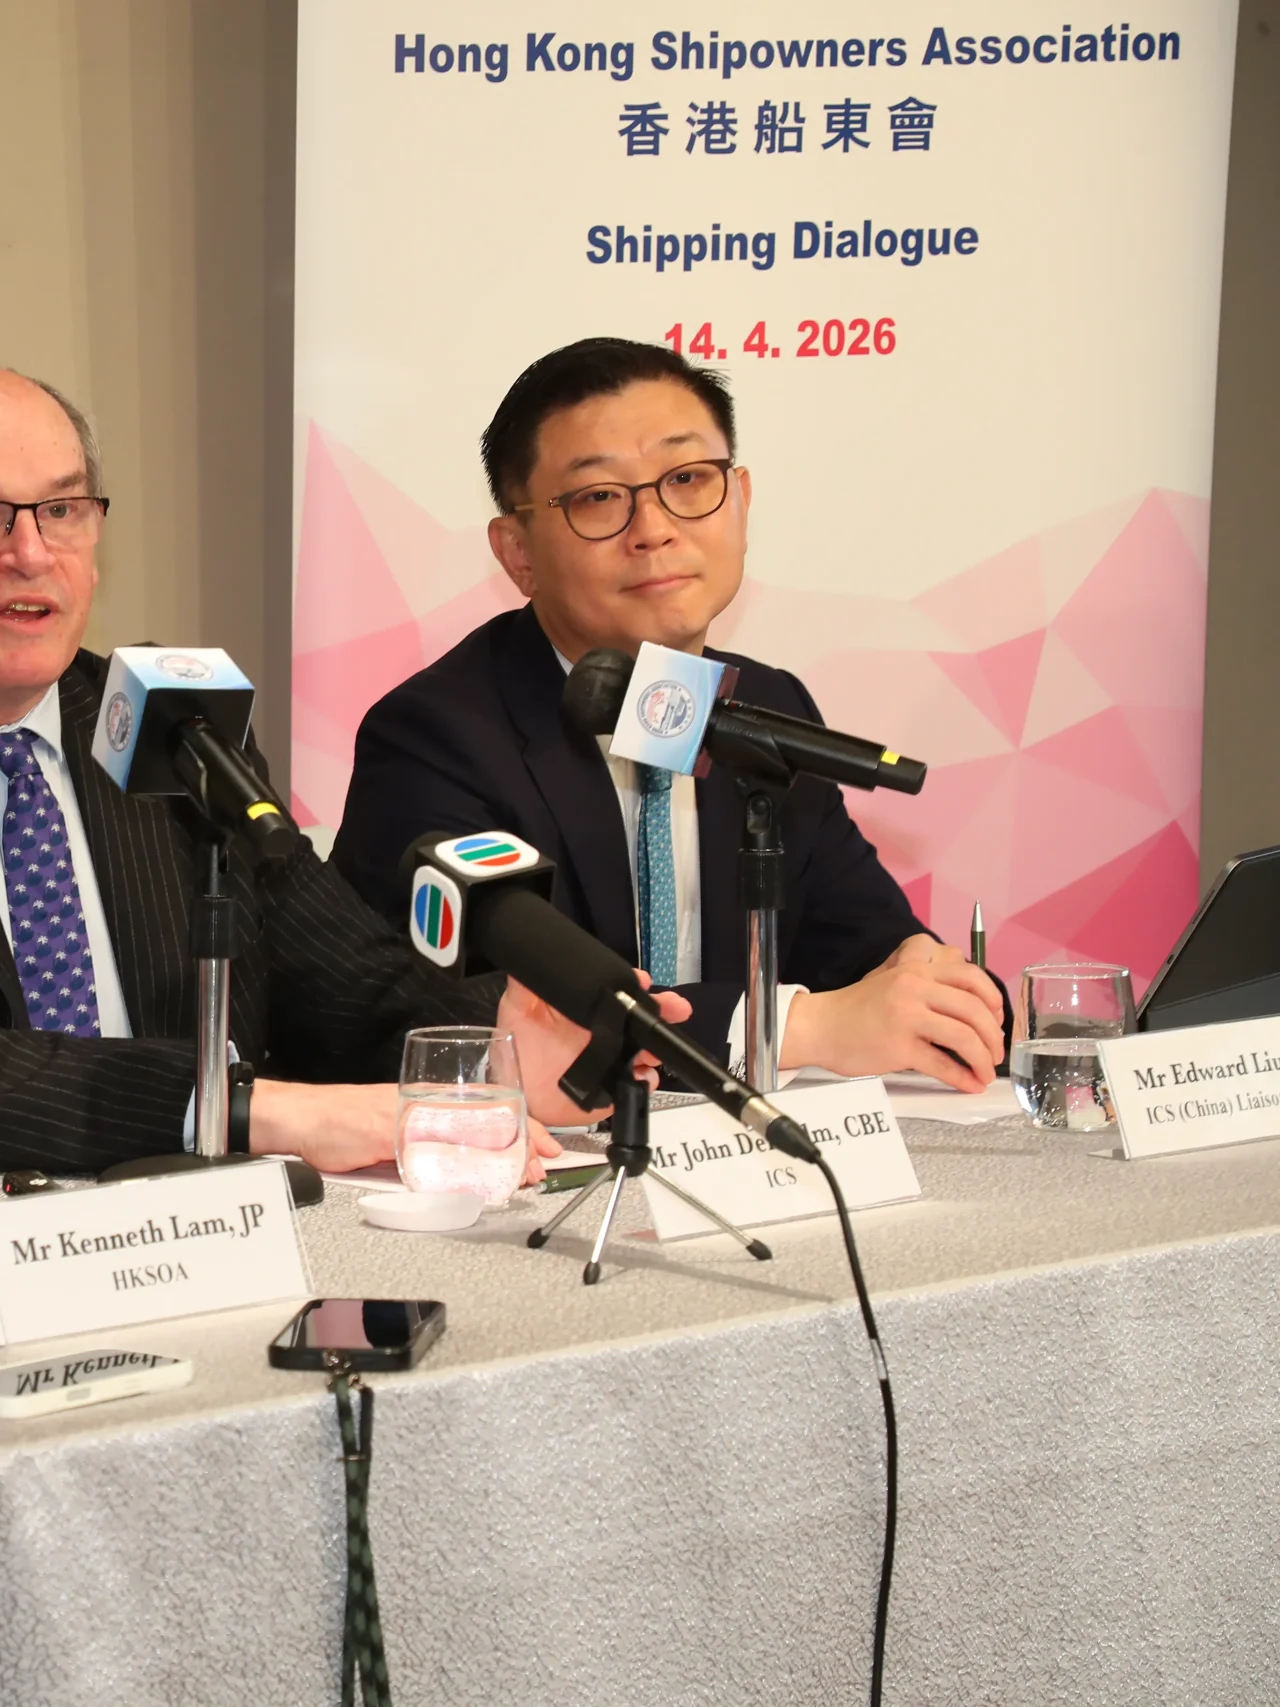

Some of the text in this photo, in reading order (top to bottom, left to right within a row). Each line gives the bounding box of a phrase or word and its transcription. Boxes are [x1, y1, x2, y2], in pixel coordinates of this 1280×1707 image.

[394, 22, 1181, 82] Hong Kong Shipowners Association
[617, 96, 938, 157] 香港船東會
[586, 220, 979, 272] Shipping Dialogue
[664, 317, 896, 360] 14. 4. 2026
[1133, 1066, 1166, 1091] Mr
[1169, 1054, 1249, 1086] Edward
[1146, 1090, 1280, 1125] ICS (China) Liaiso
[651, 1110, 891, 1172] Mr John Delm, CBE
[765, 1166, 798, 1189] ICS
[10, 1203, 265, 1266] Mr Kenneth Lam, JP
[111, 1261, 190, 1292] HKSOA
